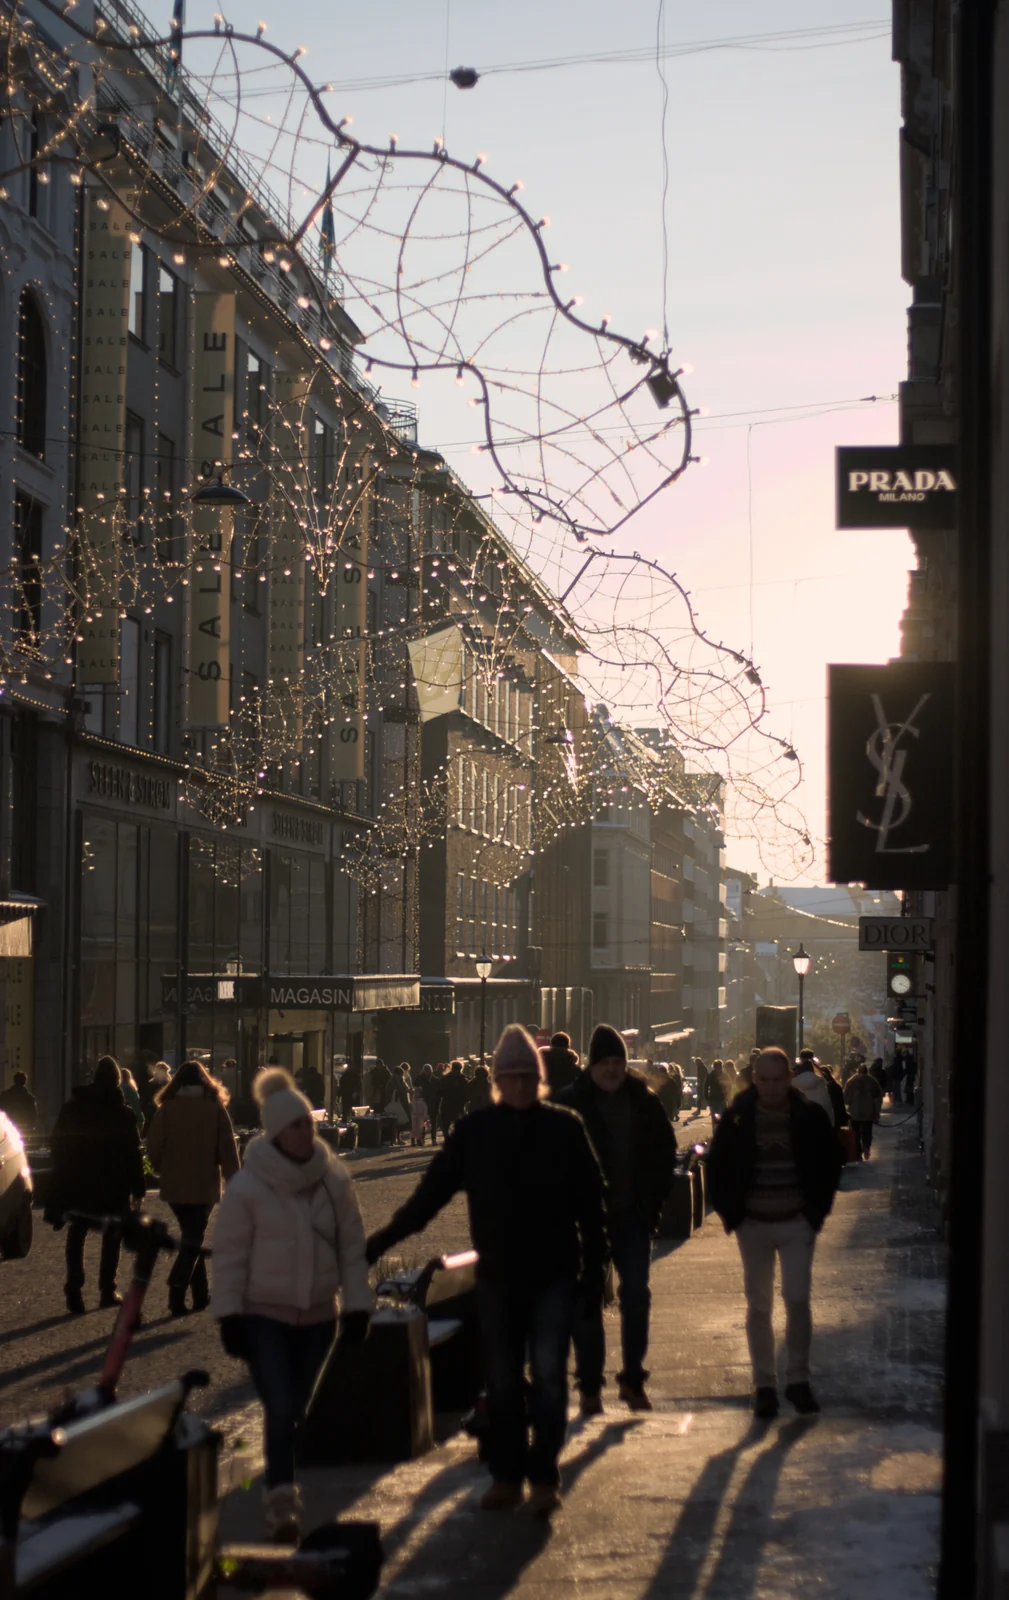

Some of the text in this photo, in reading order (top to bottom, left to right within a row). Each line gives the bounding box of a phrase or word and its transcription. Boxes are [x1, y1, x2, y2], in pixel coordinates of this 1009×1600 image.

[89, 222, 132, 231] SALE
[88, 250, 131, 260] SALE
[87, 280, 129, 288] SALE
[86, 308, 128, 317] SALE
[84, 337, 127, 346] SALE
[83, 365, 126, 375] SALE
[82, 394, 125, 404] SALE
[82, 423, 123, 433] SALE
[80, 453, 122, 462] SALE
[848, 469, 957, 492] PRADA
[79, 482, 121, 491] SALE
[878, 492, 927, 503] MILANO
[79, 658, 118, 668] SALE
[856, 693, 932, 853] YSL
[864, 923, 929, 945] DIOR
[270, 987, 351, 1005] MAGASIN
